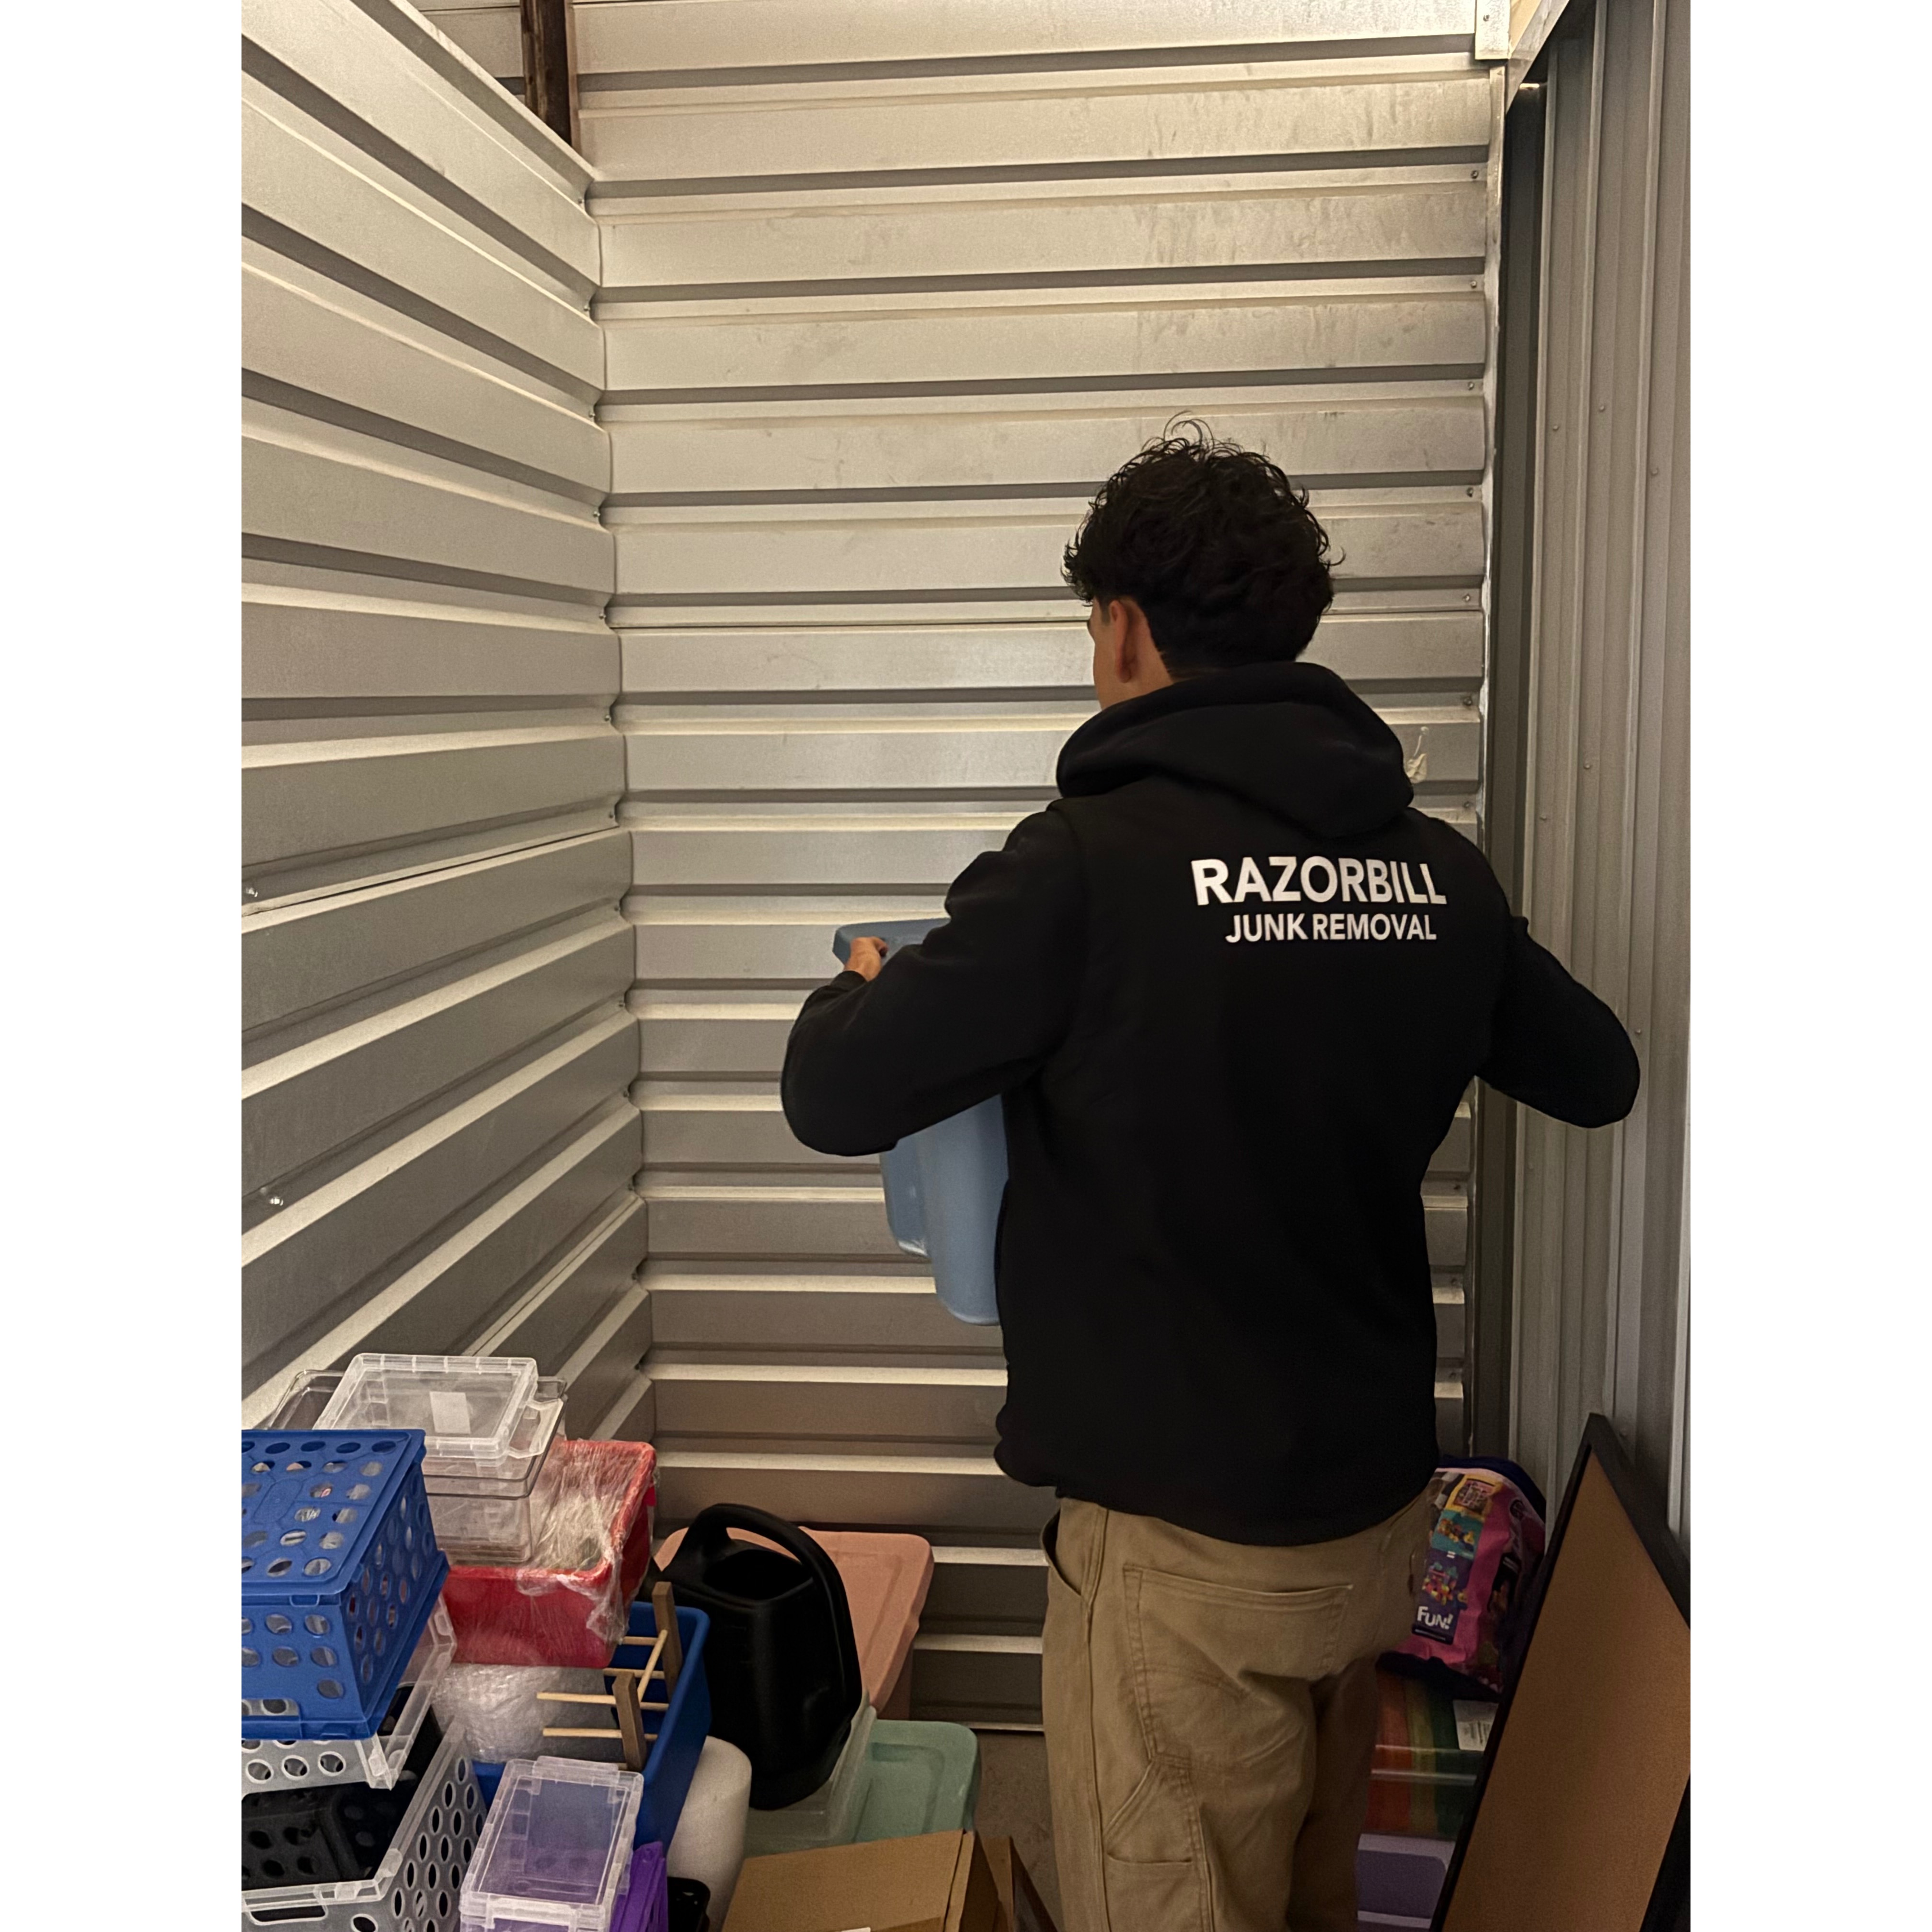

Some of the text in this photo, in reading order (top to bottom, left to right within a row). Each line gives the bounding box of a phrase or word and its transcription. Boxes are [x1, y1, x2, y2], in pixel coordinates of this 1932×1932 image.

[1191, 856, 1447, 906] RAZORBILL
[1225, 913, 1437, 943] JUNK REMOVAL
[1417, 1606, 1454, 1630] FUN!
